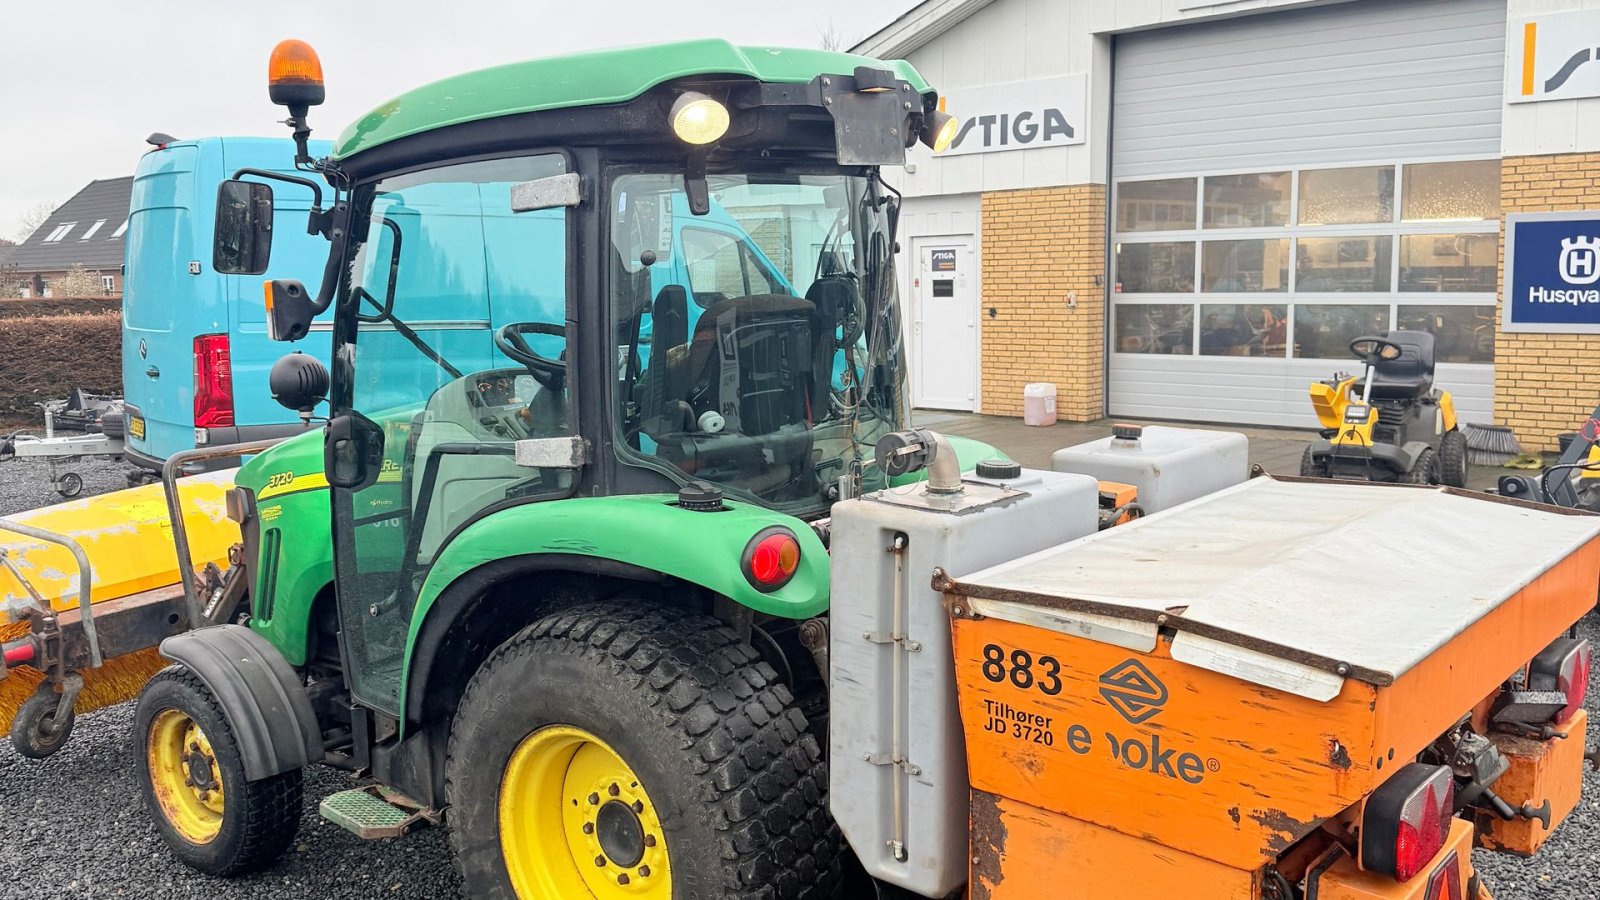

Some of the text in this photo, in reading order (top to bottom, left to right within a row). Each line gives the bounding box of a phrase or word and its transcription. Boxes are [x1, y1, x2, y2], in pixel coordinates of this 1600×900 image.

[1544, 46, 1600, 93] S
[951, 108, 1074, 150] STIGA
[932, 252, 955, 260] STIGA
[269, 471, 293, 487] 3720
[982, 643, 1063, 696] 883
[983, 699, 1053, 729] Tilhører
[984, 717, 1054, 746] JD 3720
